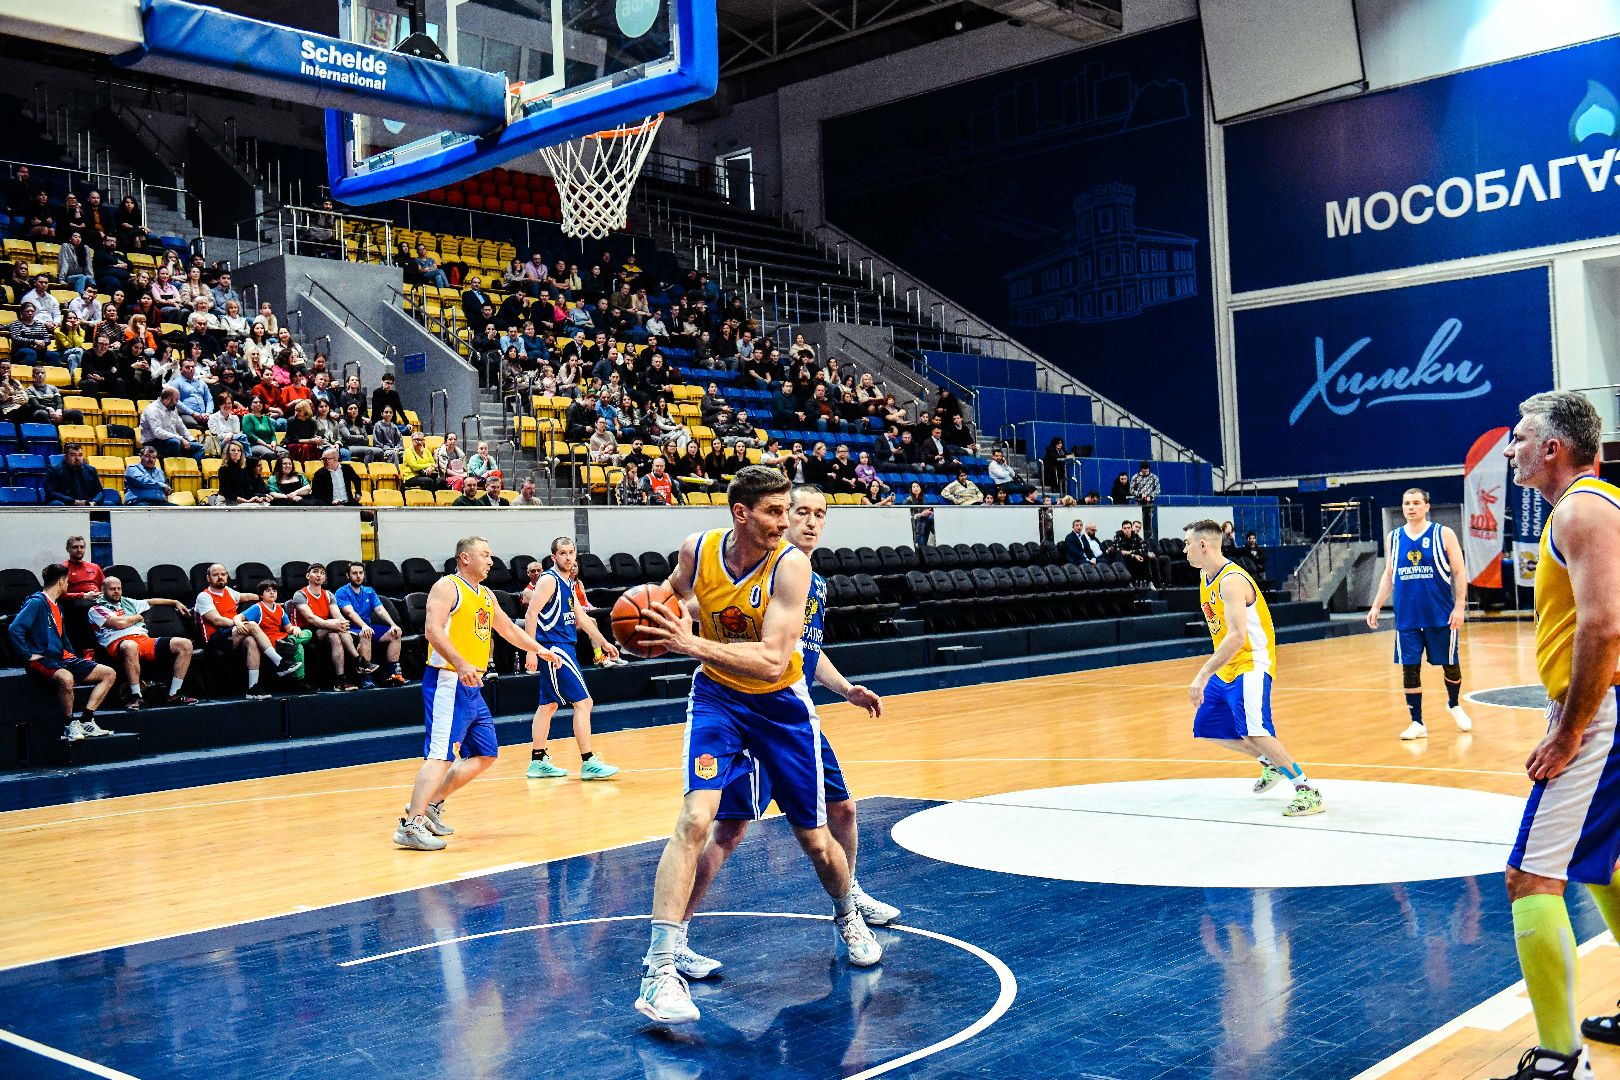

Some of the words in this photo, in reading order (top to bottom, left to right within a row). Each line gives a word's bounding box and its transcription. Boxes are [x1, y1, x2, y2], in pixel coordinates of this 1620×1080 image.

[301, 39, 388, 75] Schelde
[301, 61, 386, 91] International
[1289, 317, 1492, 426] Химки
[749, 585, 761, 608] 0
